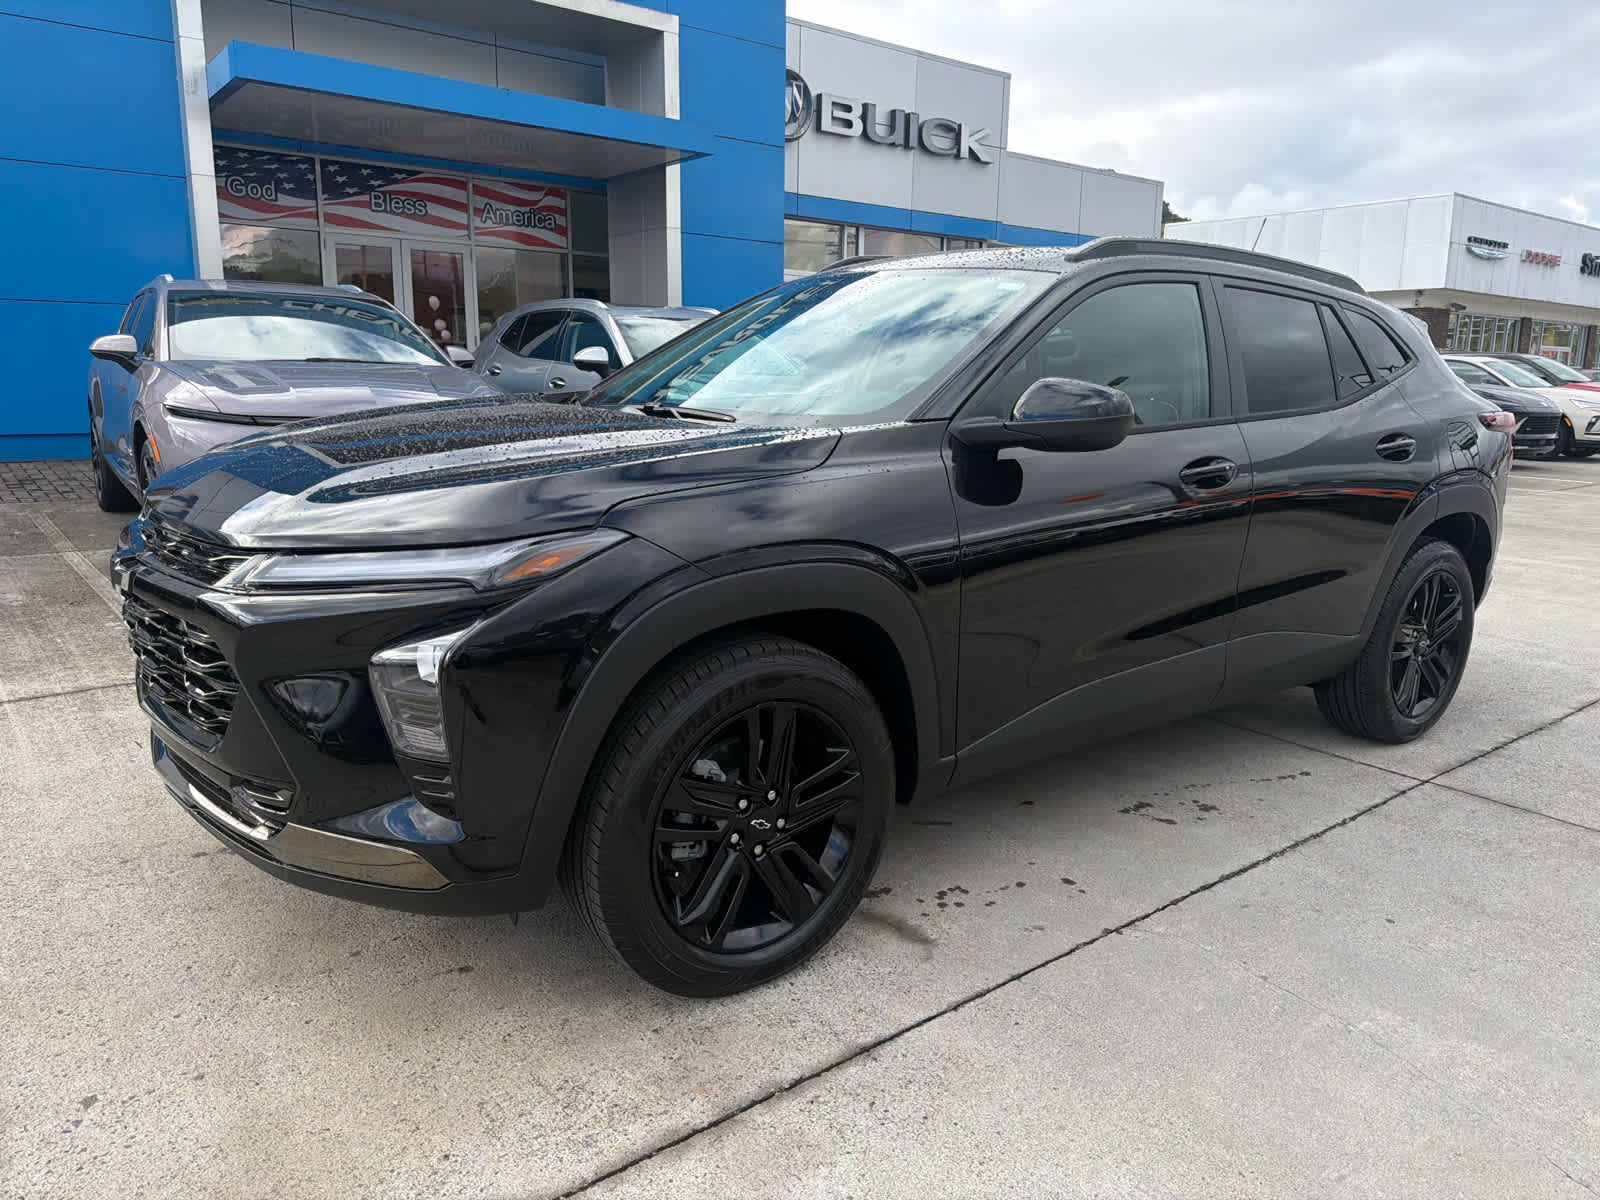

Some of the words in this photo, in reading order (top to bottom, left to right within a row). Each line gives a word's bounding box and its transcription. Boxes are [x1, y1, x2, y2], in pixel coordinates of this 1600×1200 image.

[816, 93, 994, 164] BUICK
[226, 175, 278, 201] God
[369, 191, 429, 217] Bless
[480, 203, 557, 230] America
[1521, 248, 1562, 267] DODGE
